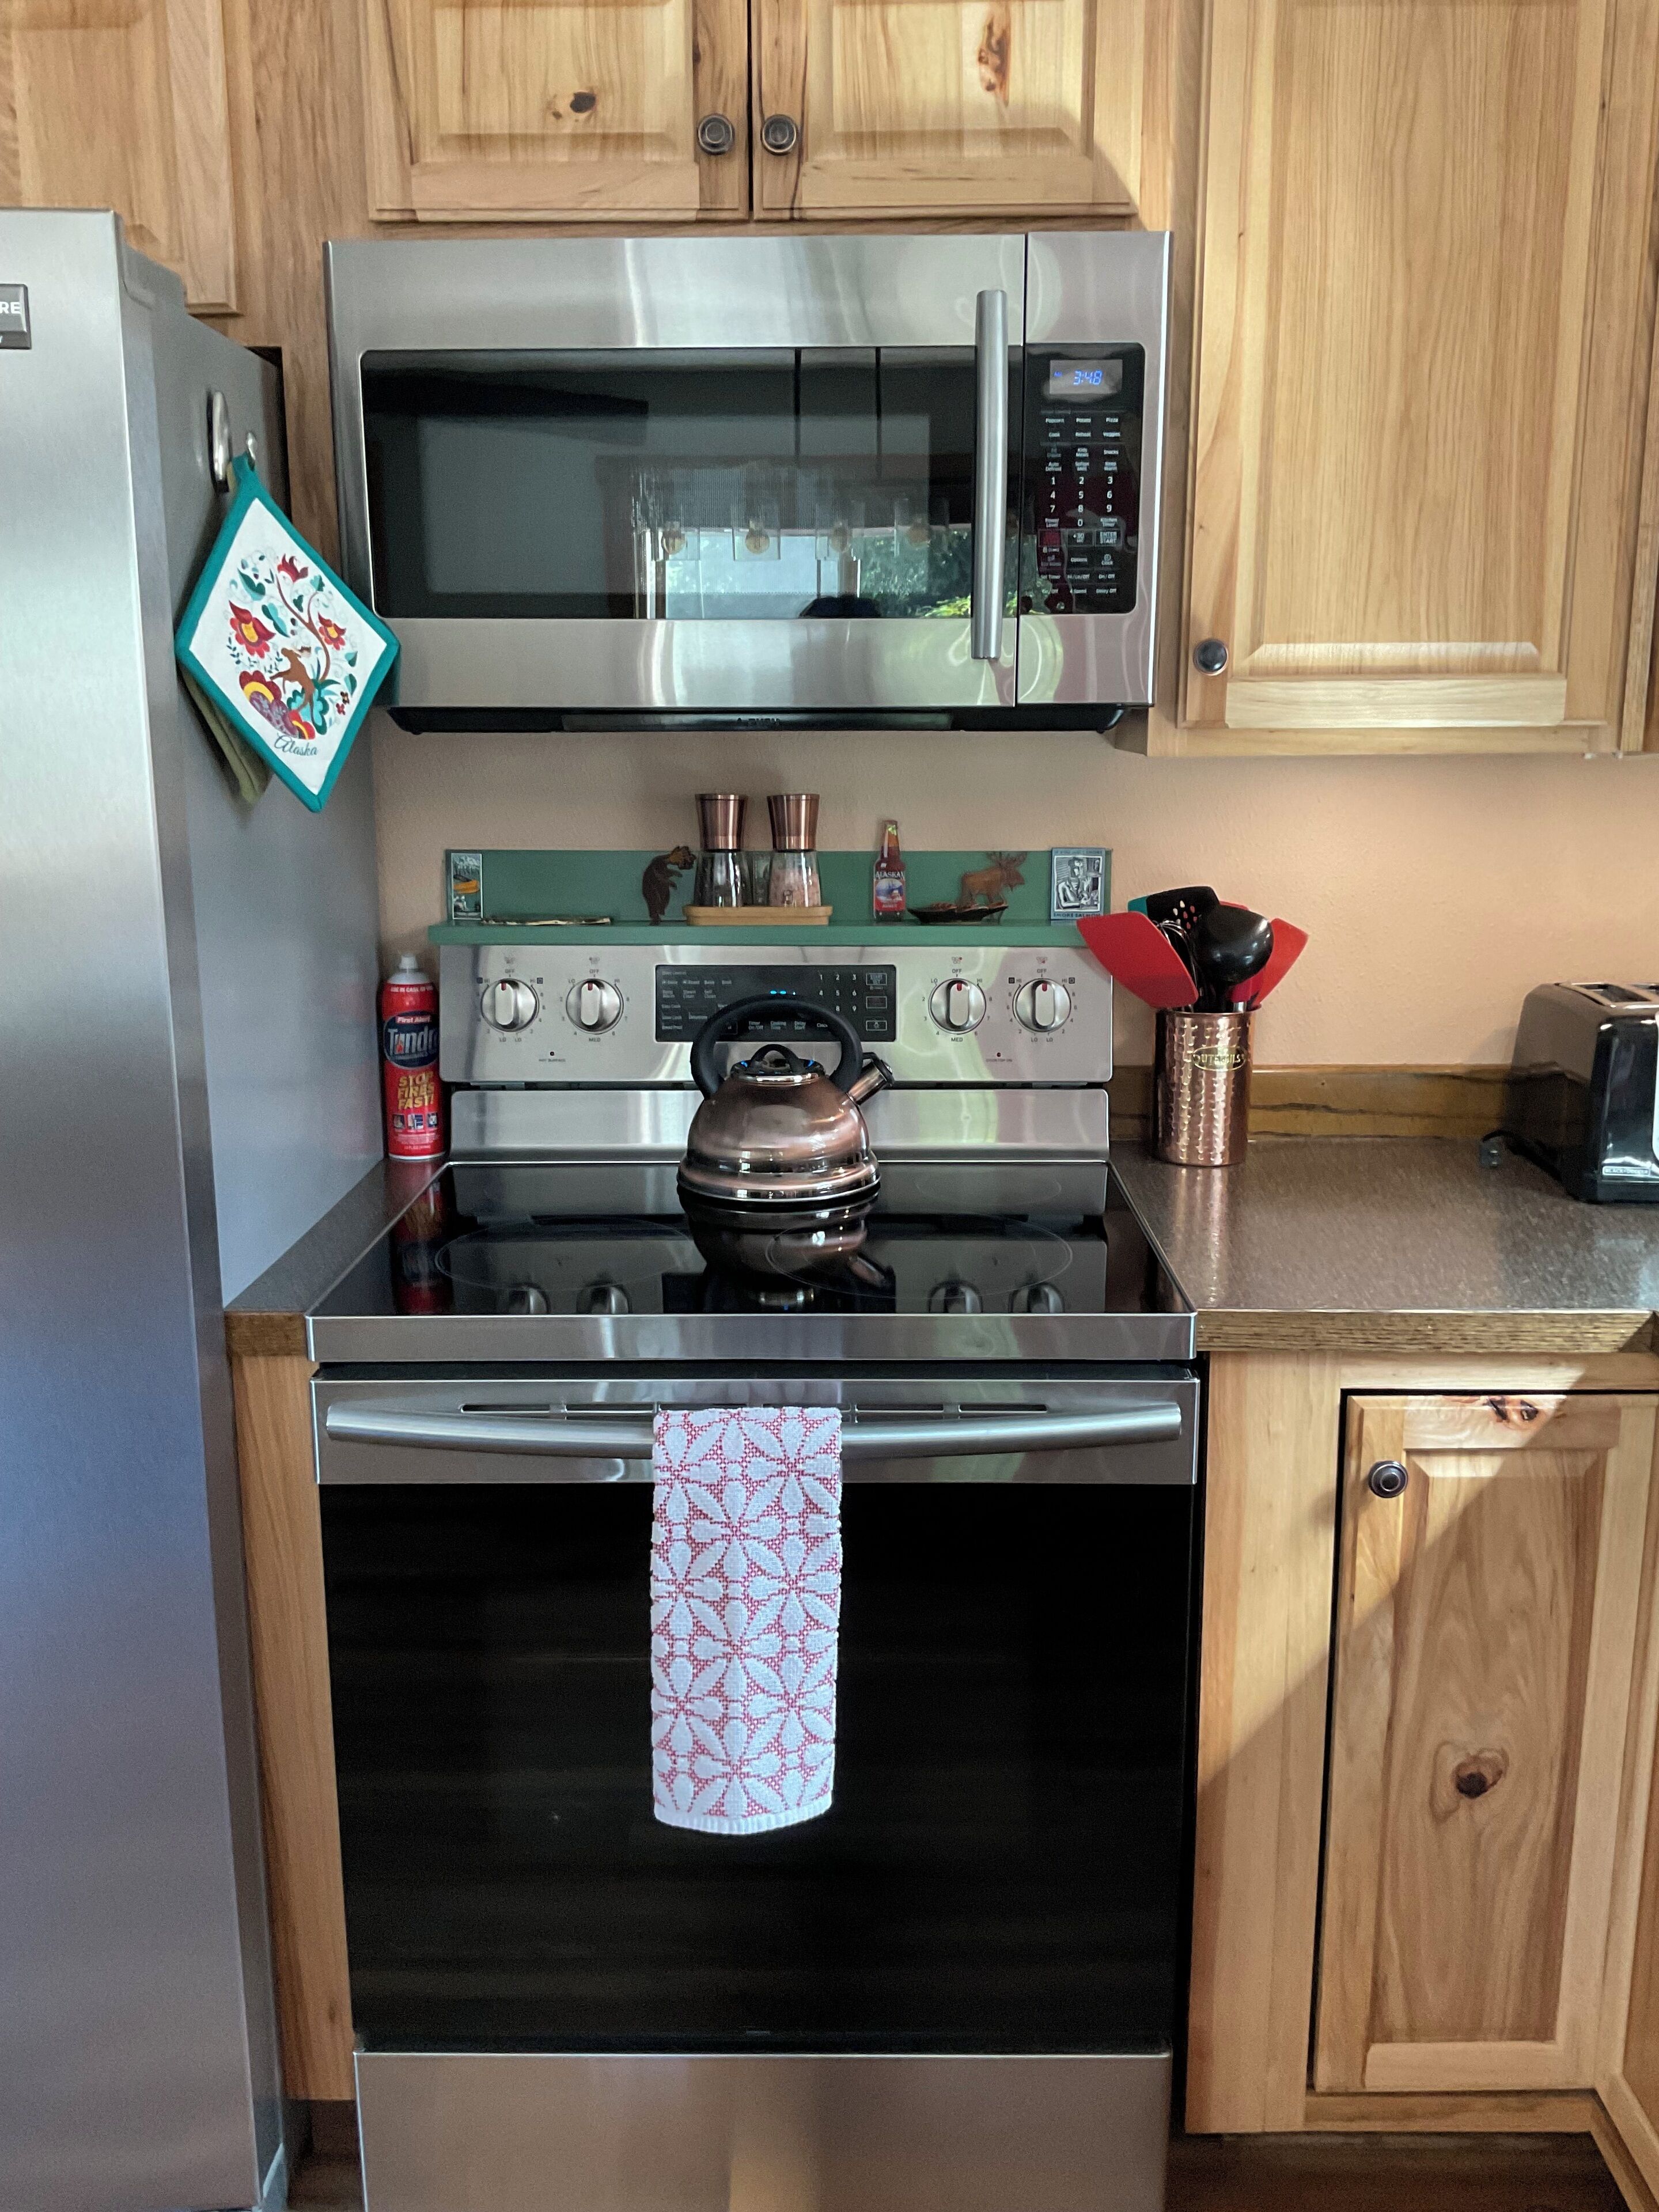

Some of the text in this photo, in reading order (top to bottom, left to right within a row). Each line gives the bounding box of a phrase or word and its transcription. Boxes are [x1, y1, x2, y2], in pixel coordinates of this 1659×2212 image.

[1073, 370, 1103, 385] 3:48
[1051, 476, 1055, 484] 1
[1079, 476, 1084, 484] 2
[1050, 491, 1055, 499] 4
[1078, 491, 1084, 499] 5
[1107, 490, 1112, 498] 6
[1050, 505, 1055, 513] 7
[1078, 505, 1083, 513] 8
[1106, 505, 1112, 513] 9
[1077, 518, 1083, 527] 0
[275, 733, 317, 756] Alaska
[876, 871, 906, 880] ALASKAN
[399, 1071, 433, 1087] STOP
[397, 1082, 435, 1099] FIRES
[397, 1094, 434, 1110] FAST!
